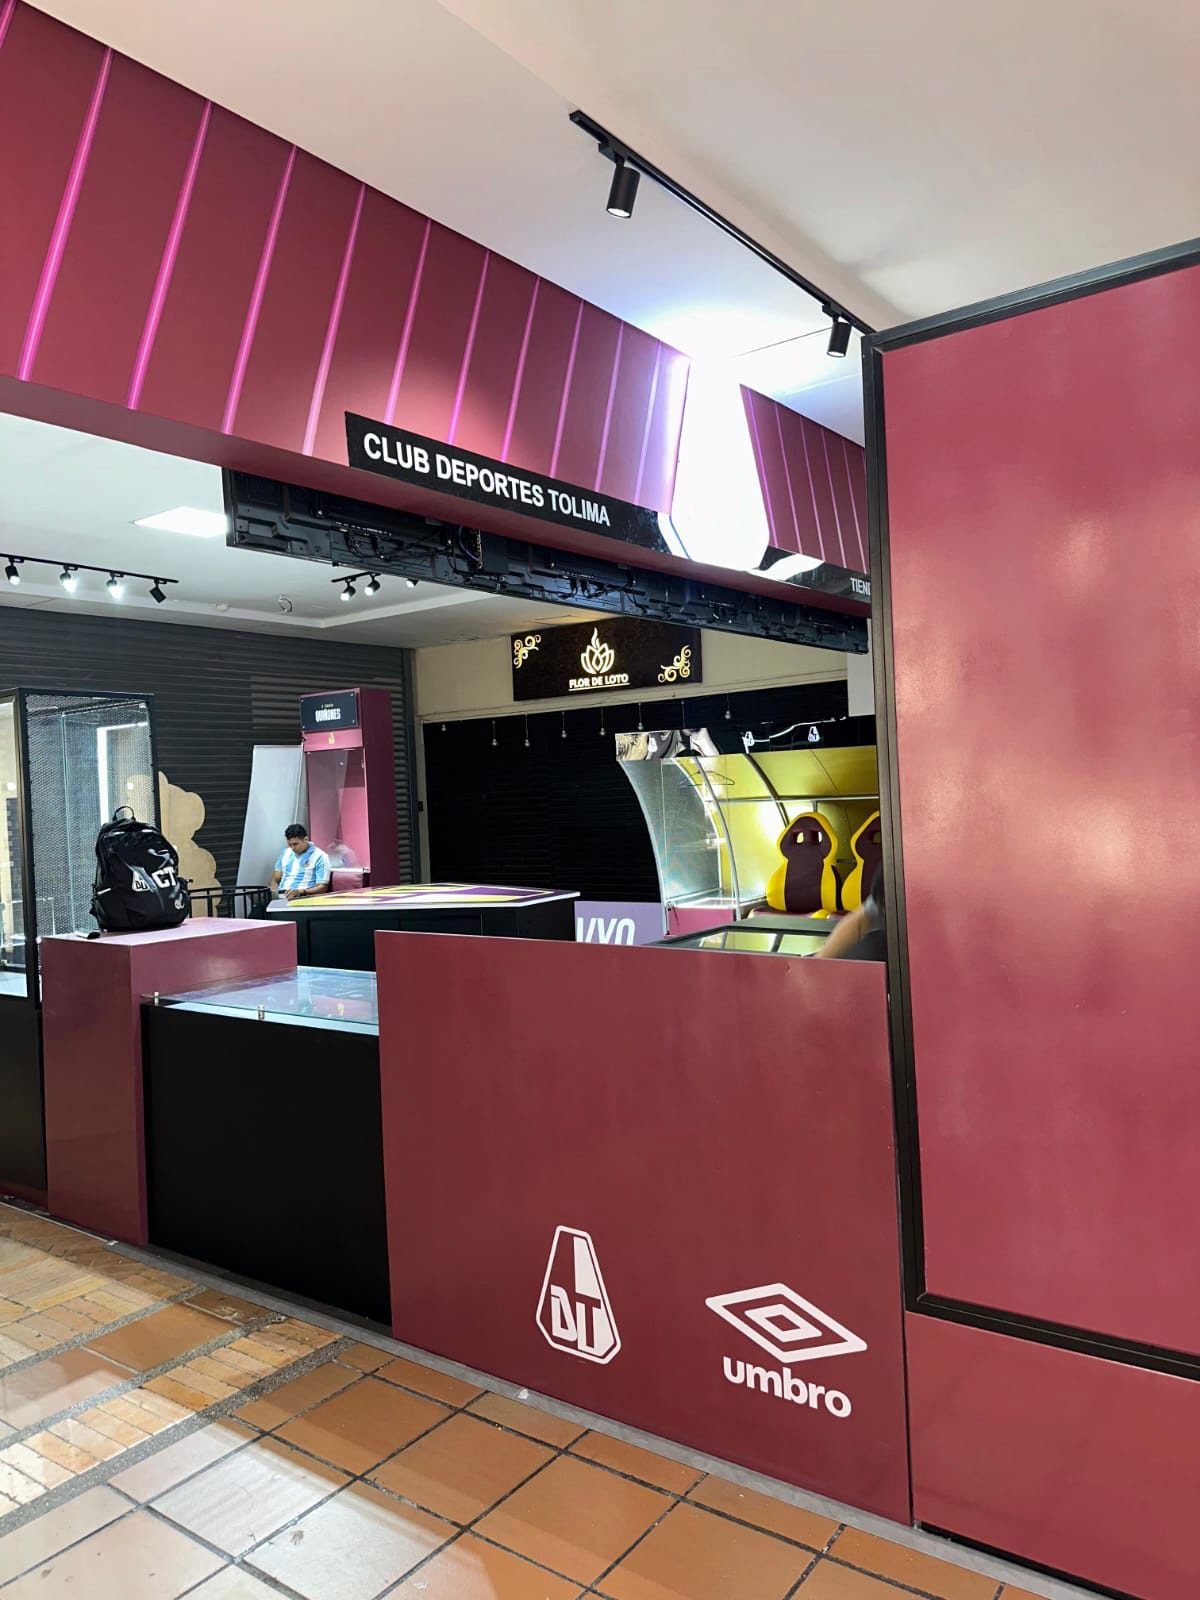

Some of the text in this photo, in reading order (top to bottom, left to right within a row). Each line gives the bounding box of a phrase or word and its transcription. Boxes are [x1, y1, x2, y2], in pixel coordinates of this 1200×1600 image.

[363, 431, 611, 528] CLUB DEPORTES TOLIMA
[569, 673, 629, 689] FLOR DE LOTO
[723, 1356, 852, 1419] umbro
